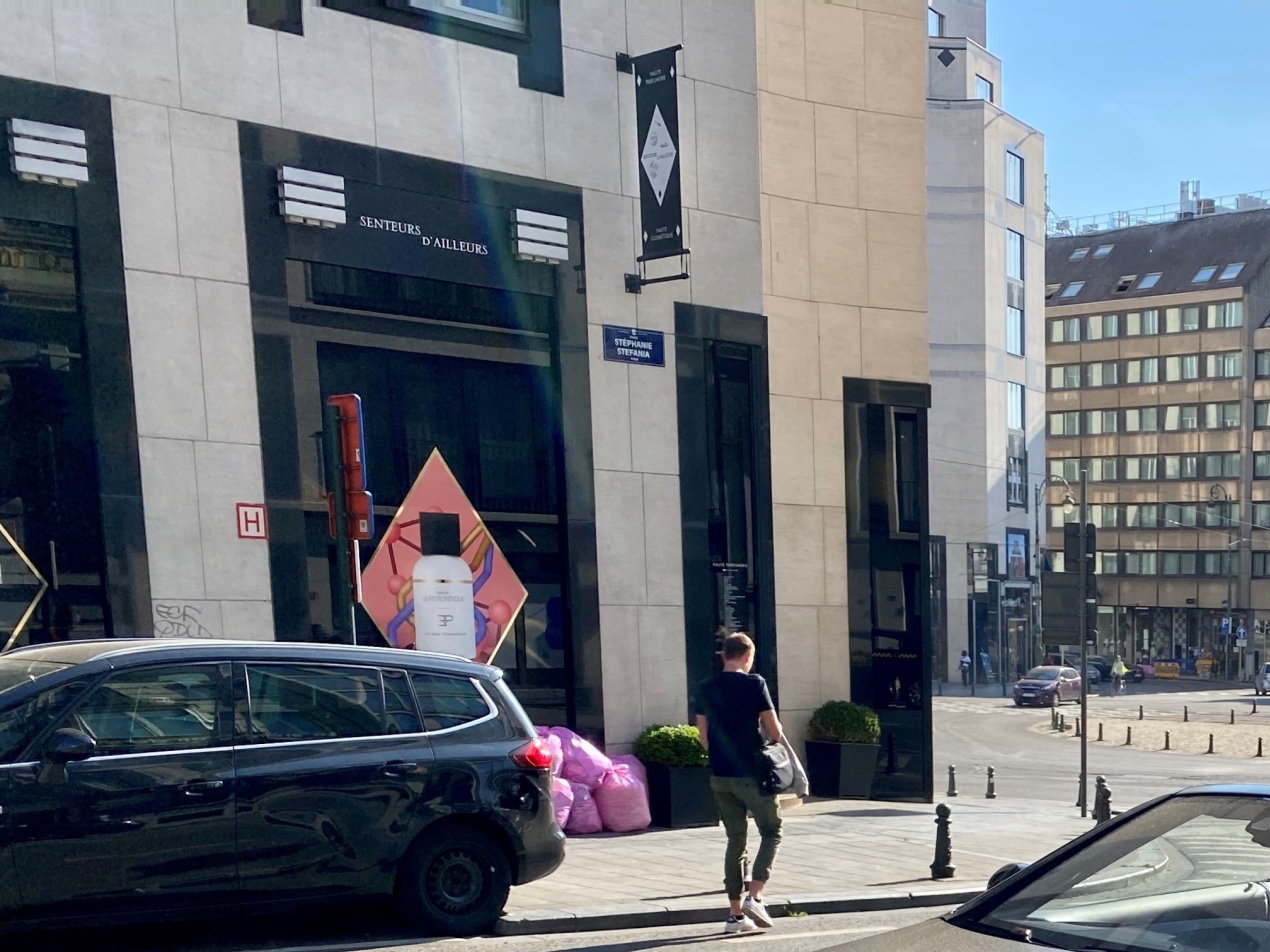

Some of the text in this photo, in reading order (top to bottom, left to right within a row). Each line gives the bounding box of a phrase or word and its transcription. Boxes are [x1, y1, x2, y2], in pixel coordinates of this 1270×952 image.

[360, 216, 421, 235] SENTEURS
[422, 236, 488, 255] D'AILLEURS
[614, 337, 653, 350] STÉPHANIE
[617, 347, 651, 359] STEFANIA
[244, 511, 260, 532] H
